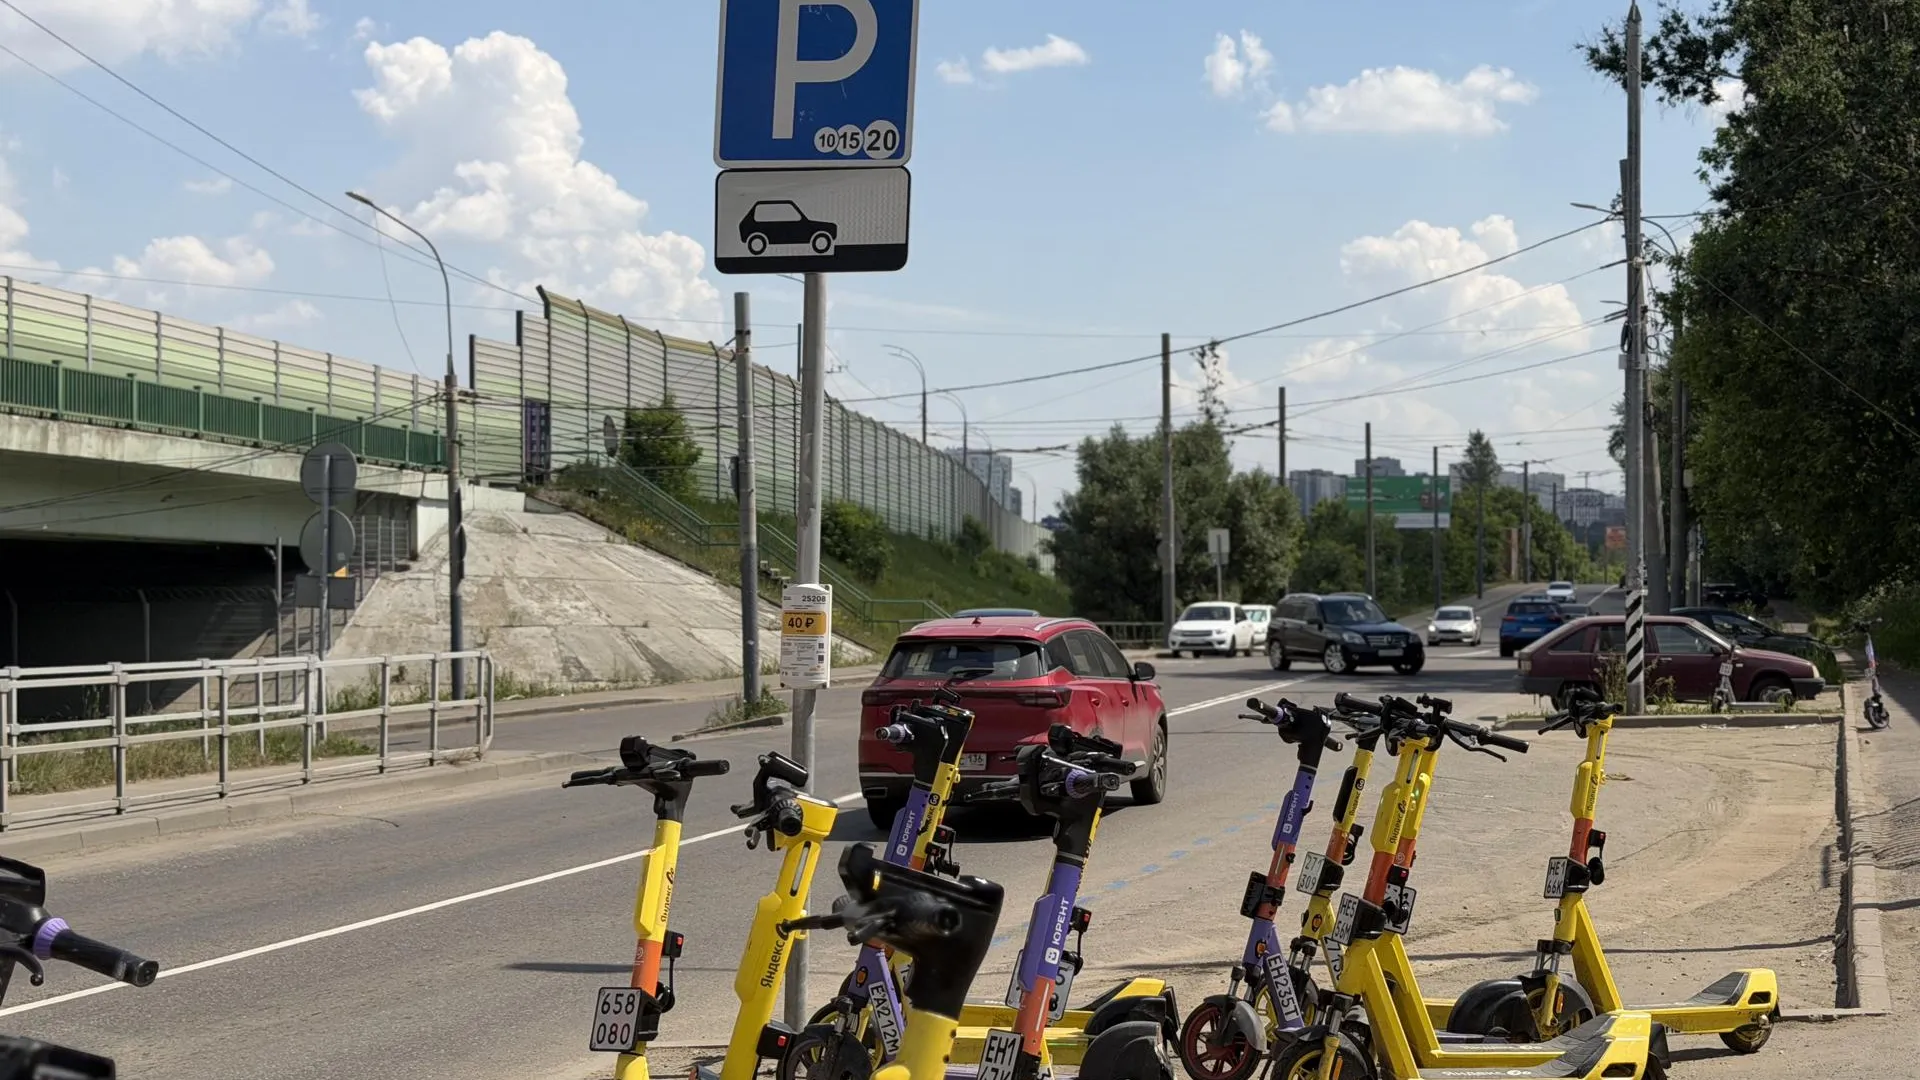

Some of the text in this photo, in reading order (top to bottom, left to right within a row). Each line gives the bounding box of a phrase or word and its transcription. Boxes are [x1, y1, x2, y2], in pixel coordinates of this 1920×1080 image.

[772, 0, 878, 139] P
[818, 129, 897, 151] 10 15 20
[788, 617, 803, 629] 40
[1288, 792, 1300, 822] ЮРЕНТ
[902, 811, 916, 843] ЮРЕНТ
[1052, 897, 1069, 945] ЮРЕНТ
[760, 940, 785, 988] Яндекс
[601, 993, 635, 1015] 658
[596, 1023, 630, 1045] 080
